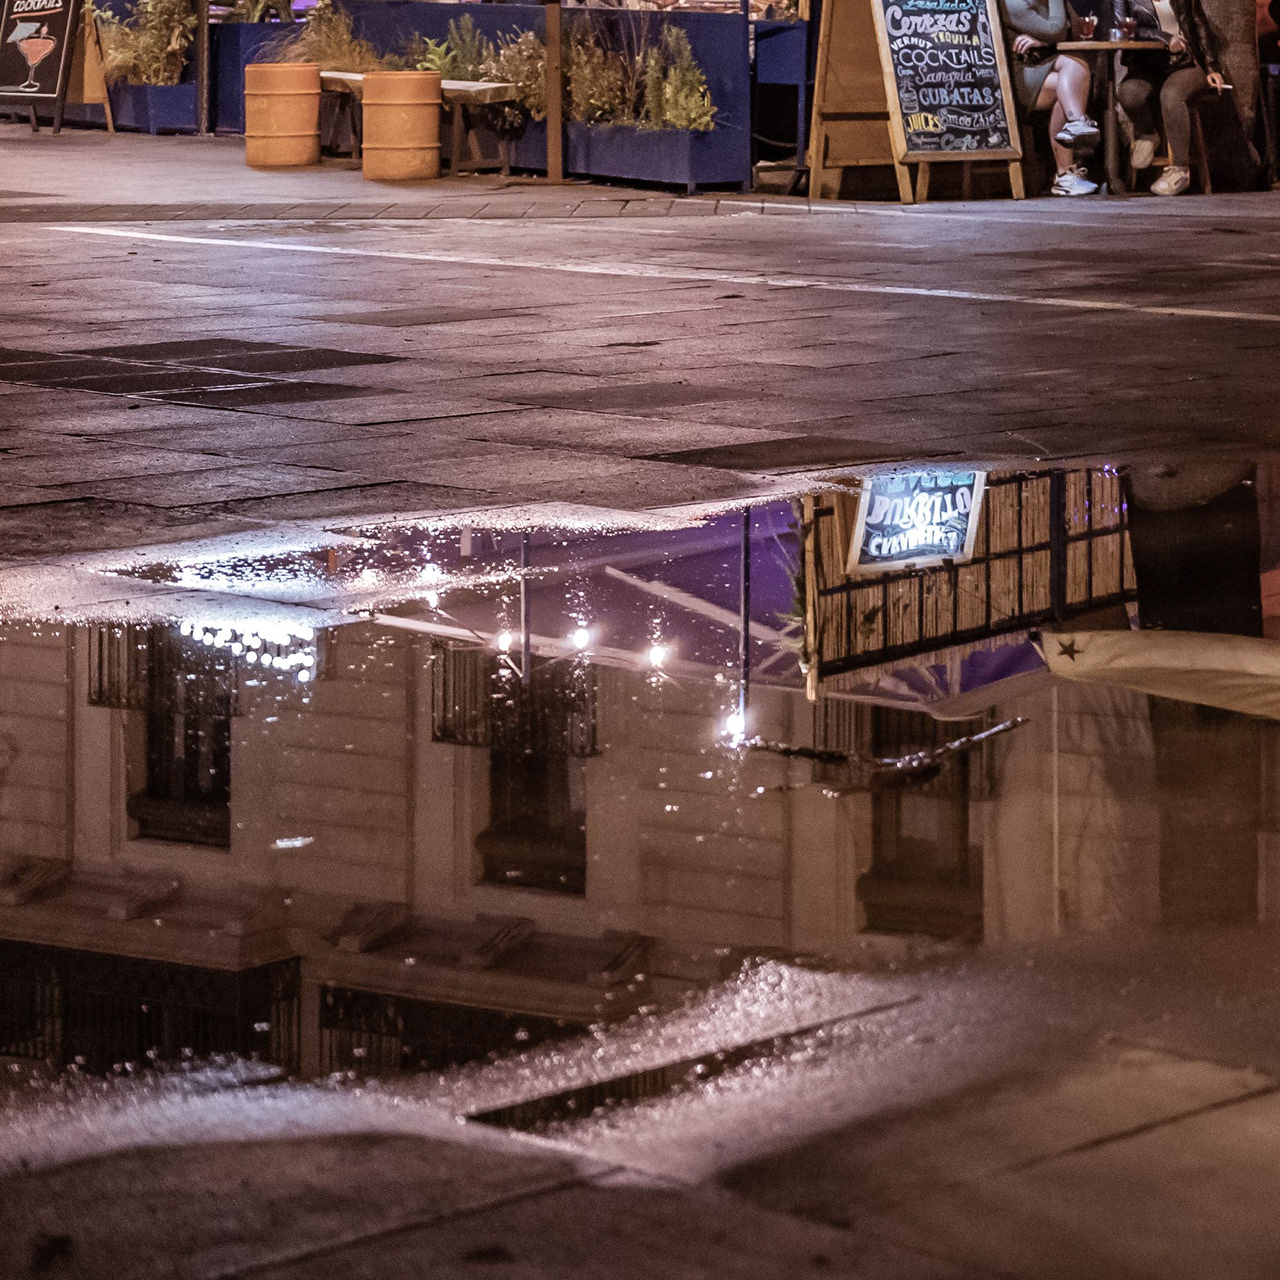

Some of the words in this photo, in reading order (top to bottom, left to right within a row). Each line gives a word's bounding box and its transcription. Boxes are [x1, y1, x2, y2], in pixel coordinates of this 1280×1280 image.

[890, 36, 933, 51] VERMUT
[931, 31, 980, 46] TEQUILA
[899, 47, 996, 69] COCKTAILS
[919, 87, 994, 106] CUBATAS
[907, 112, 941, 133] JUICES
